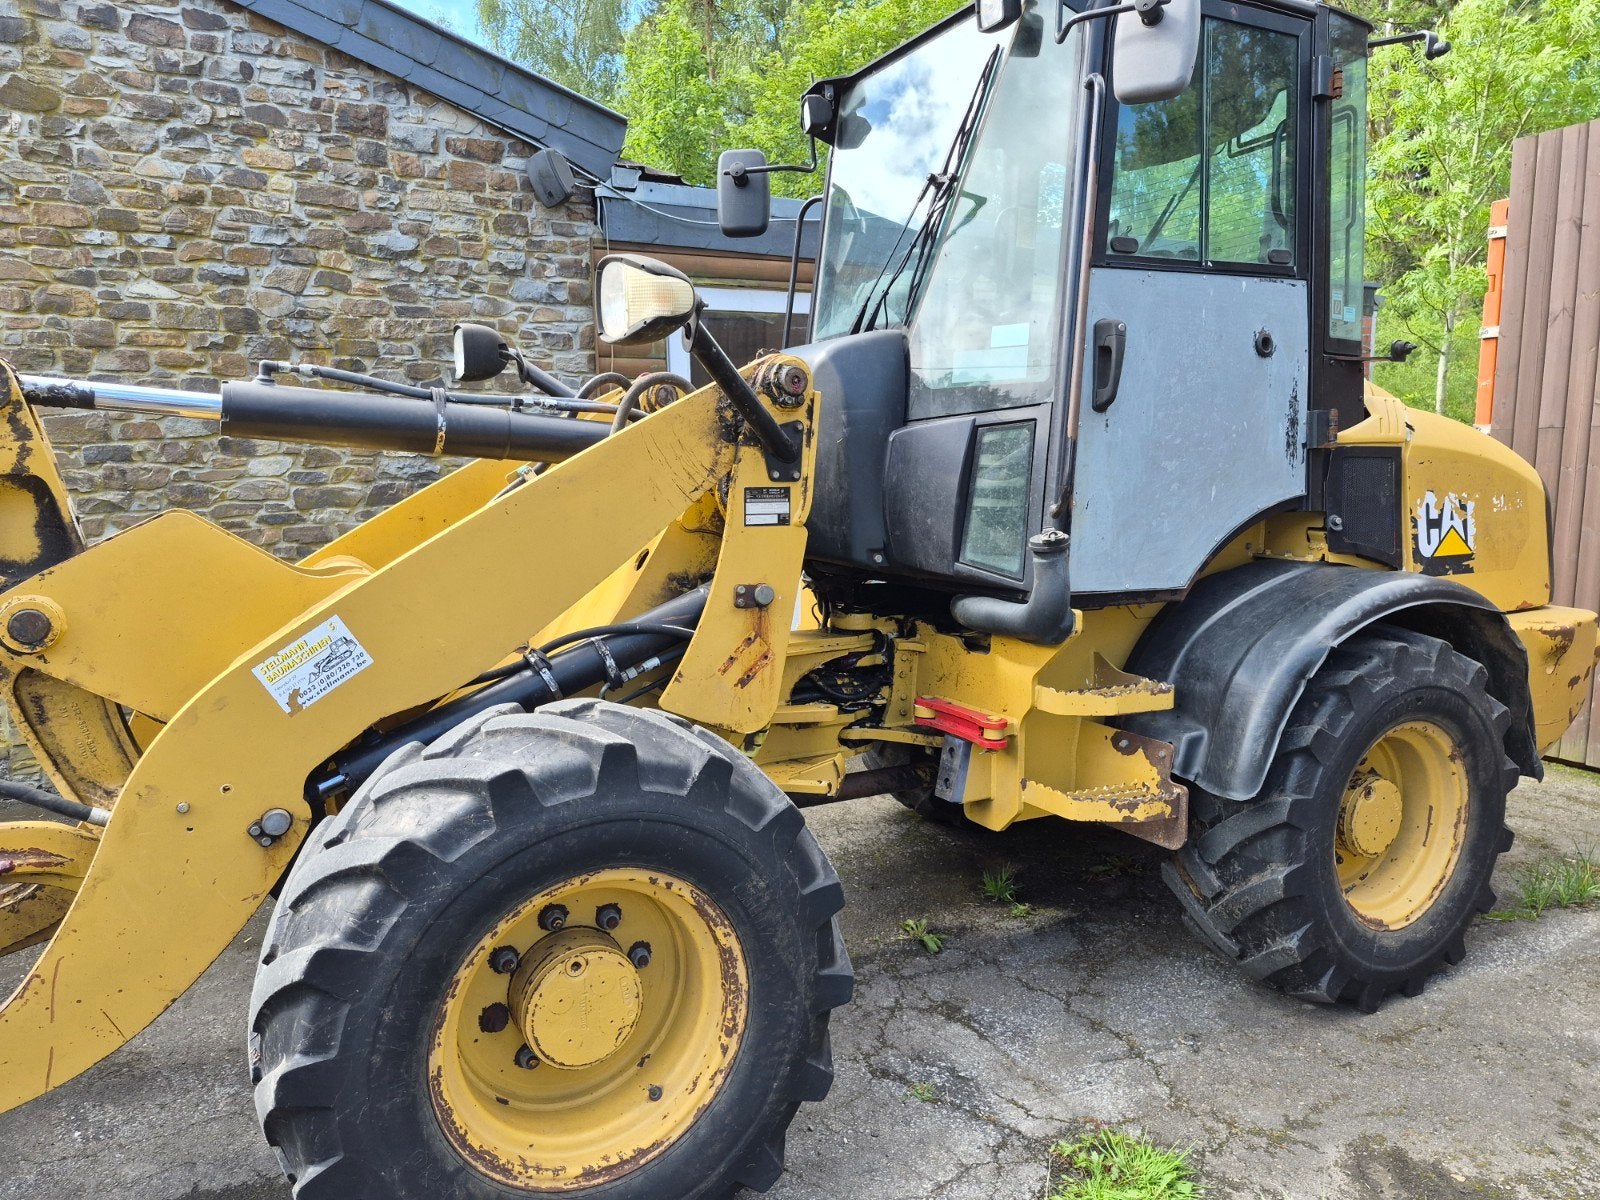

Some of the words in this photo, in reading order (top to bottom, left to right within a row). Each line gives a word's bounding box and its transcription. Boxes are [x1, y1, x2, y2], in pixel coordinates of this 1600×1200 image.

[259, 640, 309, 675] STELLMANN
[265, 635, 333, 683] BAUMASCHINEN
[301, 659, 367, 705] ww.stellmann.be
